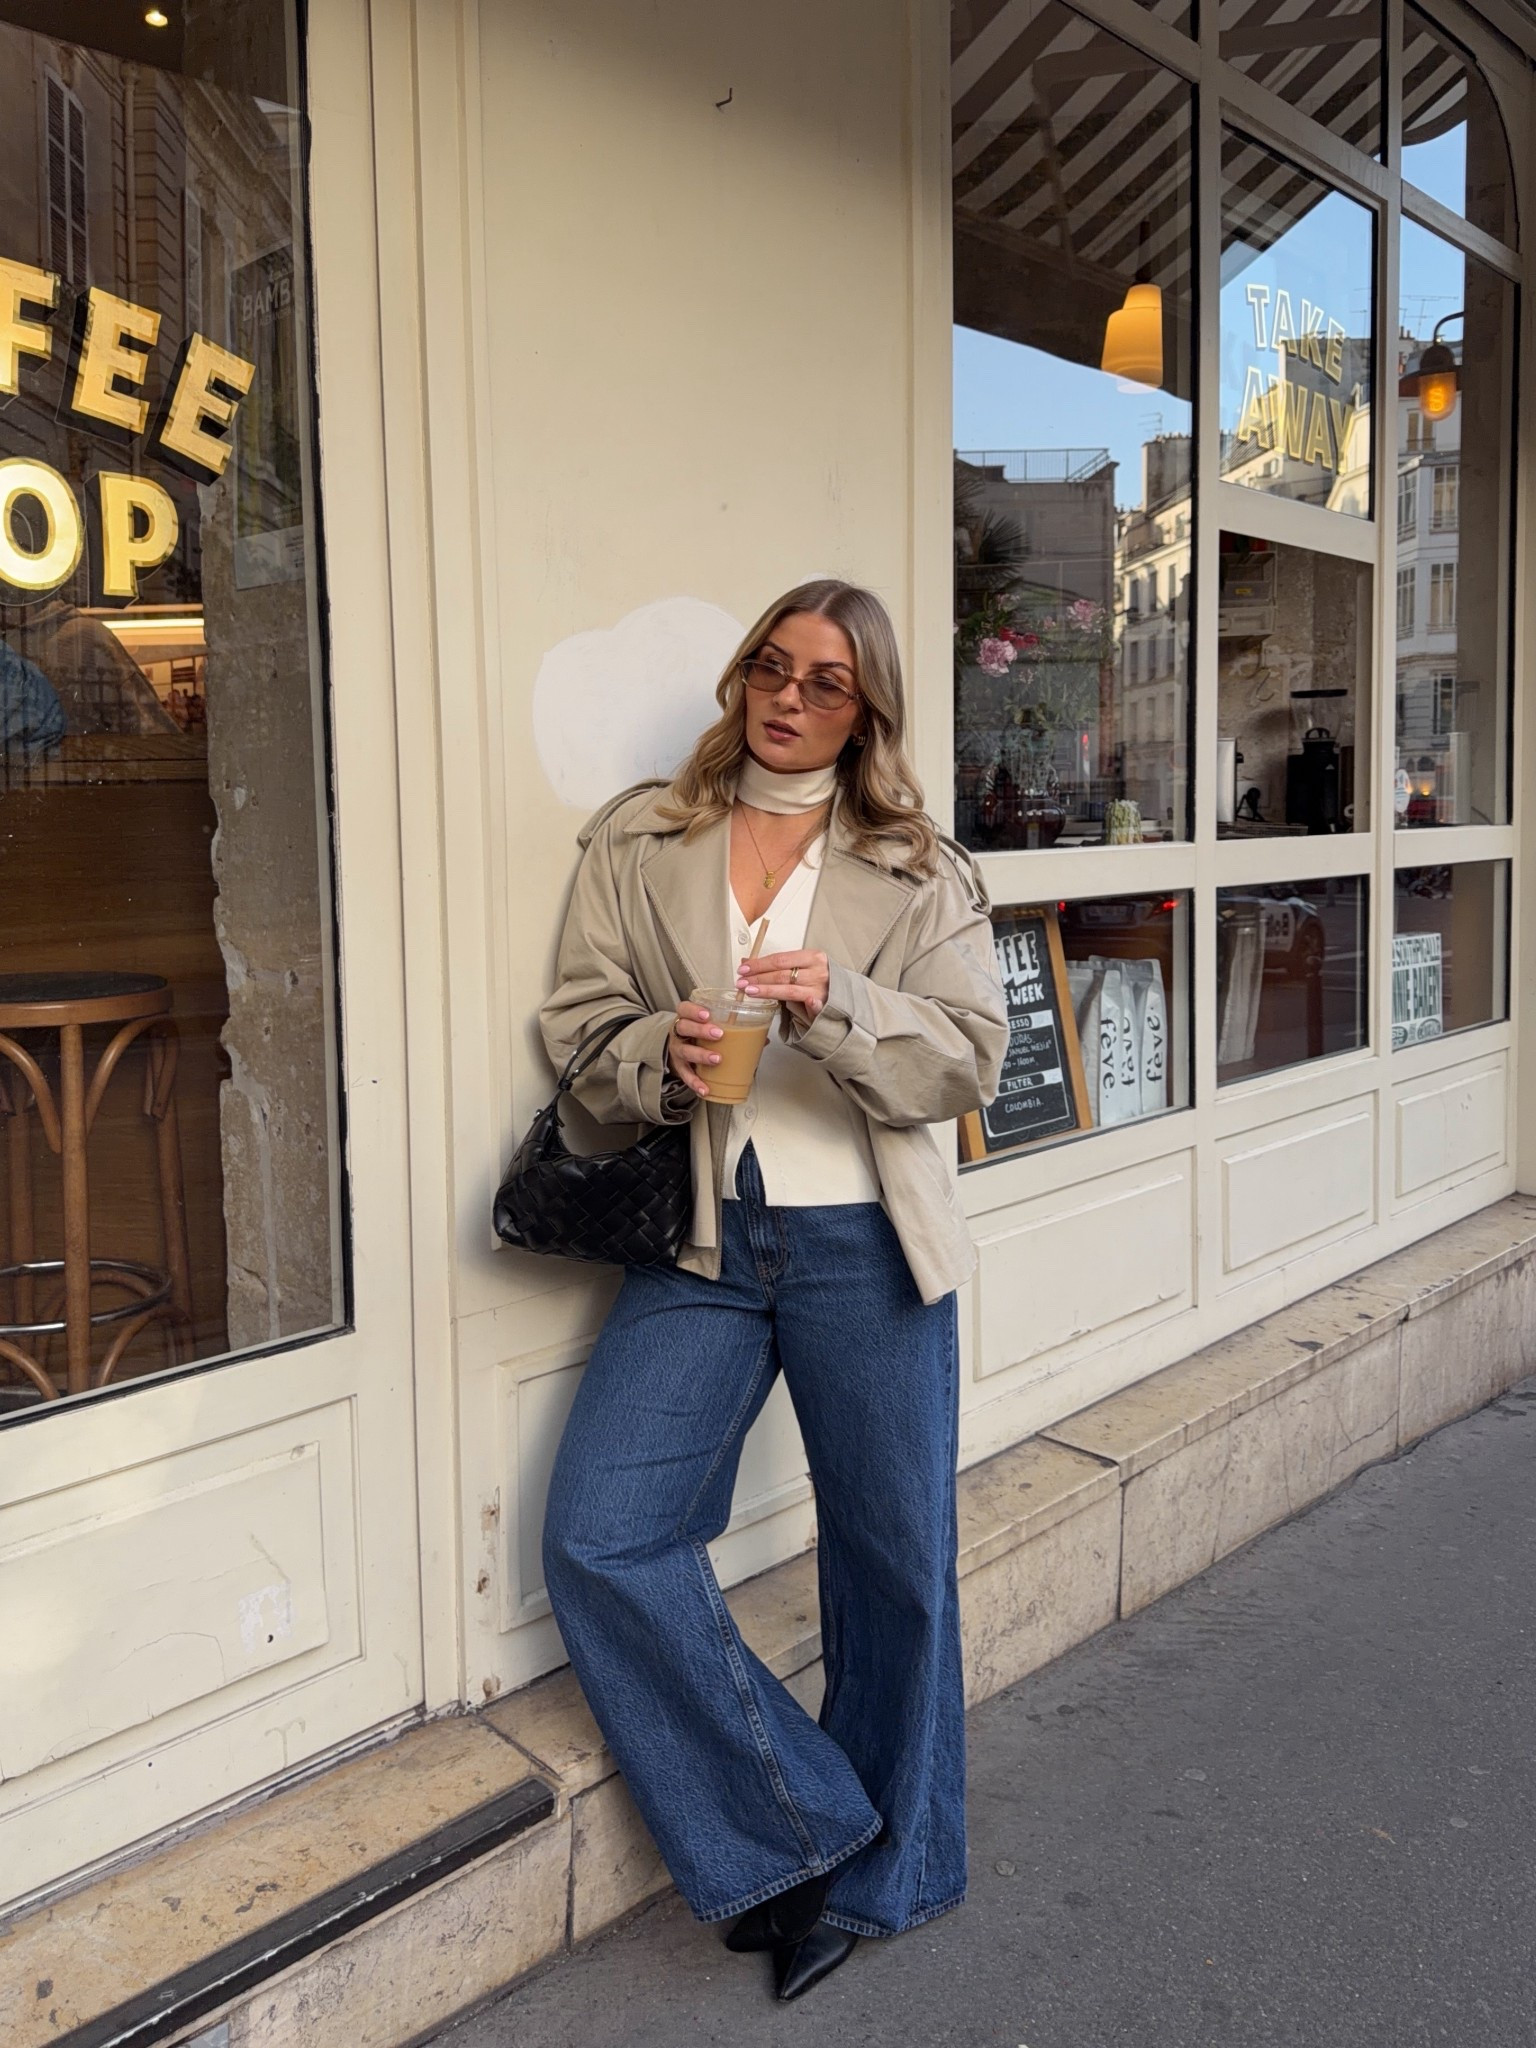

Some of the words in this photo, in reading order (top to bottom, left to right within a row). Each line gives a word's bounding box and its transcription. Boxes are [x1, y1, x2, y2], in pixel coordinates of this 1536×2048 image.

[1246, 284, 1345, 385] TAKE
[1238, 366, 1355, 475] AWAY
[0, 457, 179, 597] OP
[1010, 983, 1044, 1005] WEEK
[1007, 1077, 1033, 1091] FILTER
